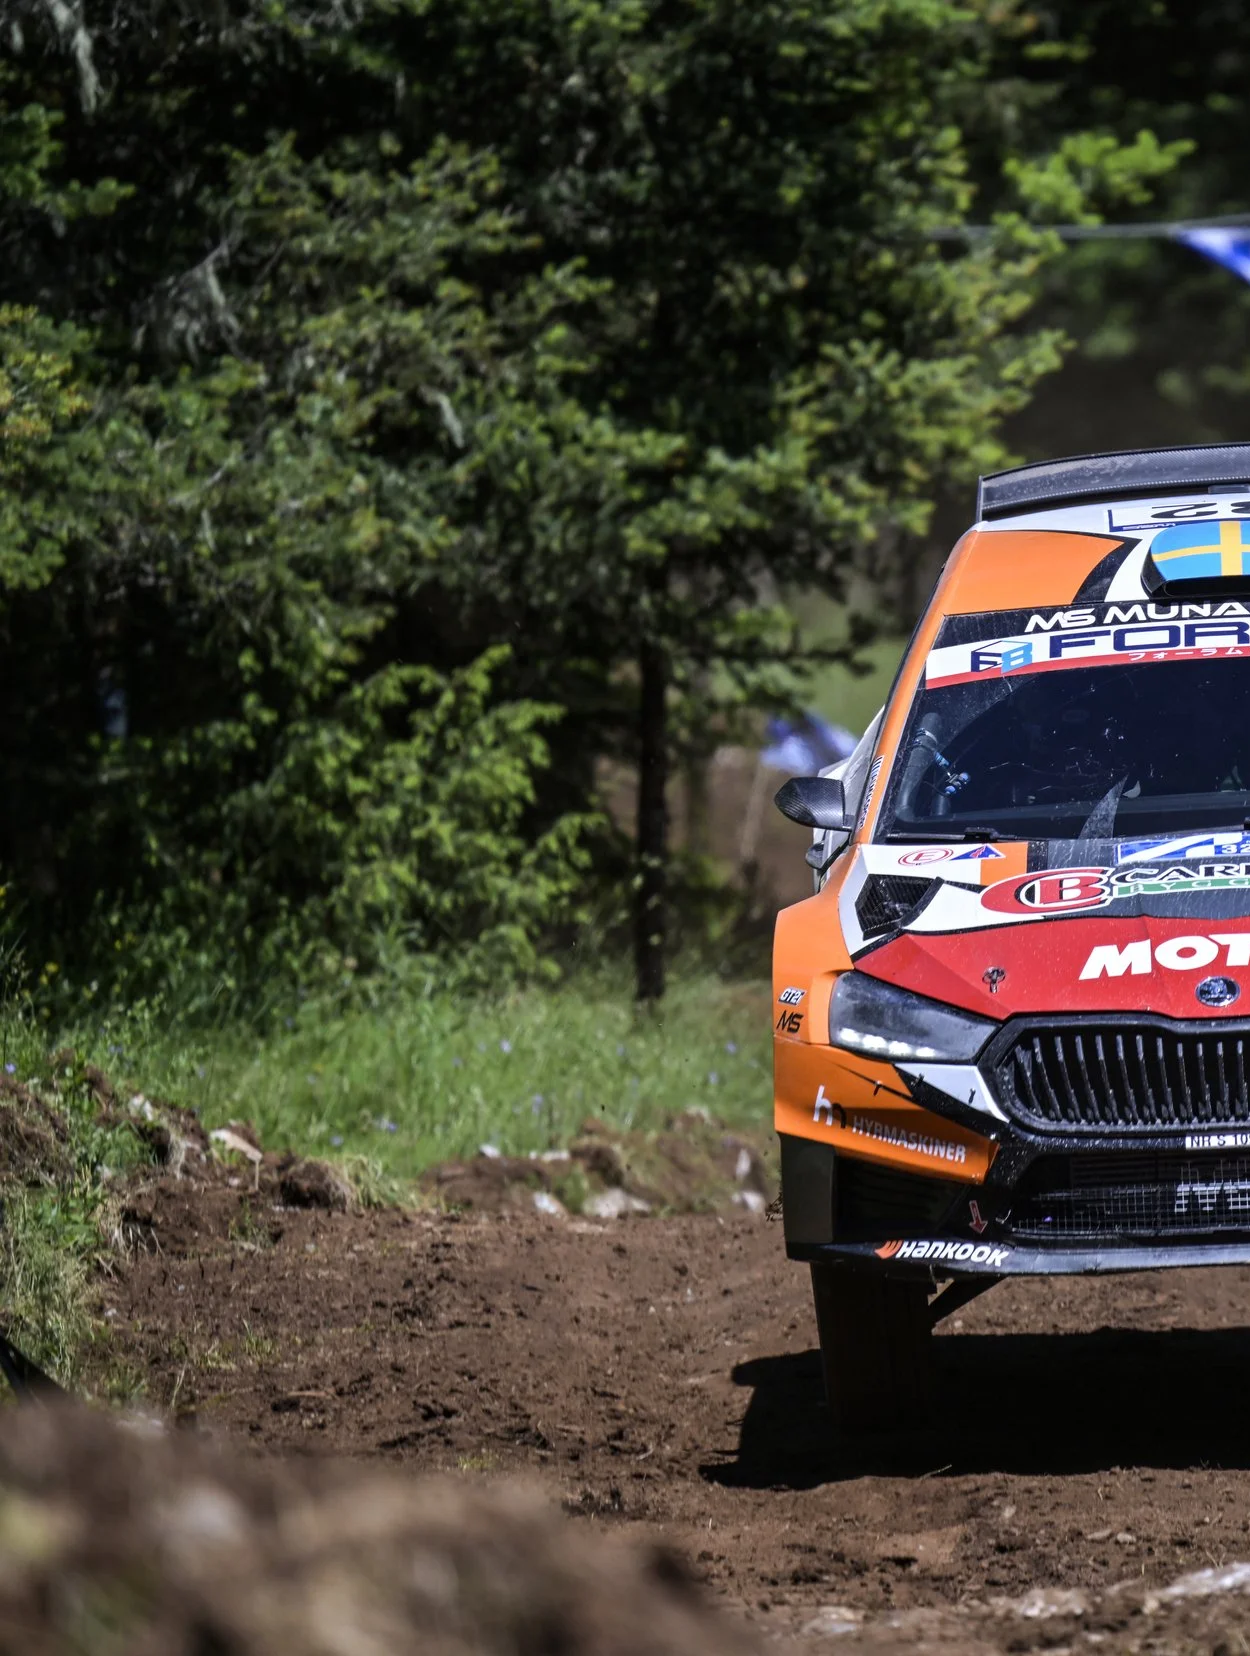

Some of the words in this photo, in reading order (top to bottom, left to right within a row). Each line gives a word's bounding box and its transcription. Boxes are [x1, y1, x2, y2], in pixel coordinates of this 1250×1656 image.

[1024, 607, 1096, 633] MS
[776, 1010, 804, 1033] MS
[852, 1115, 967, 1163] HYRMASKINER
